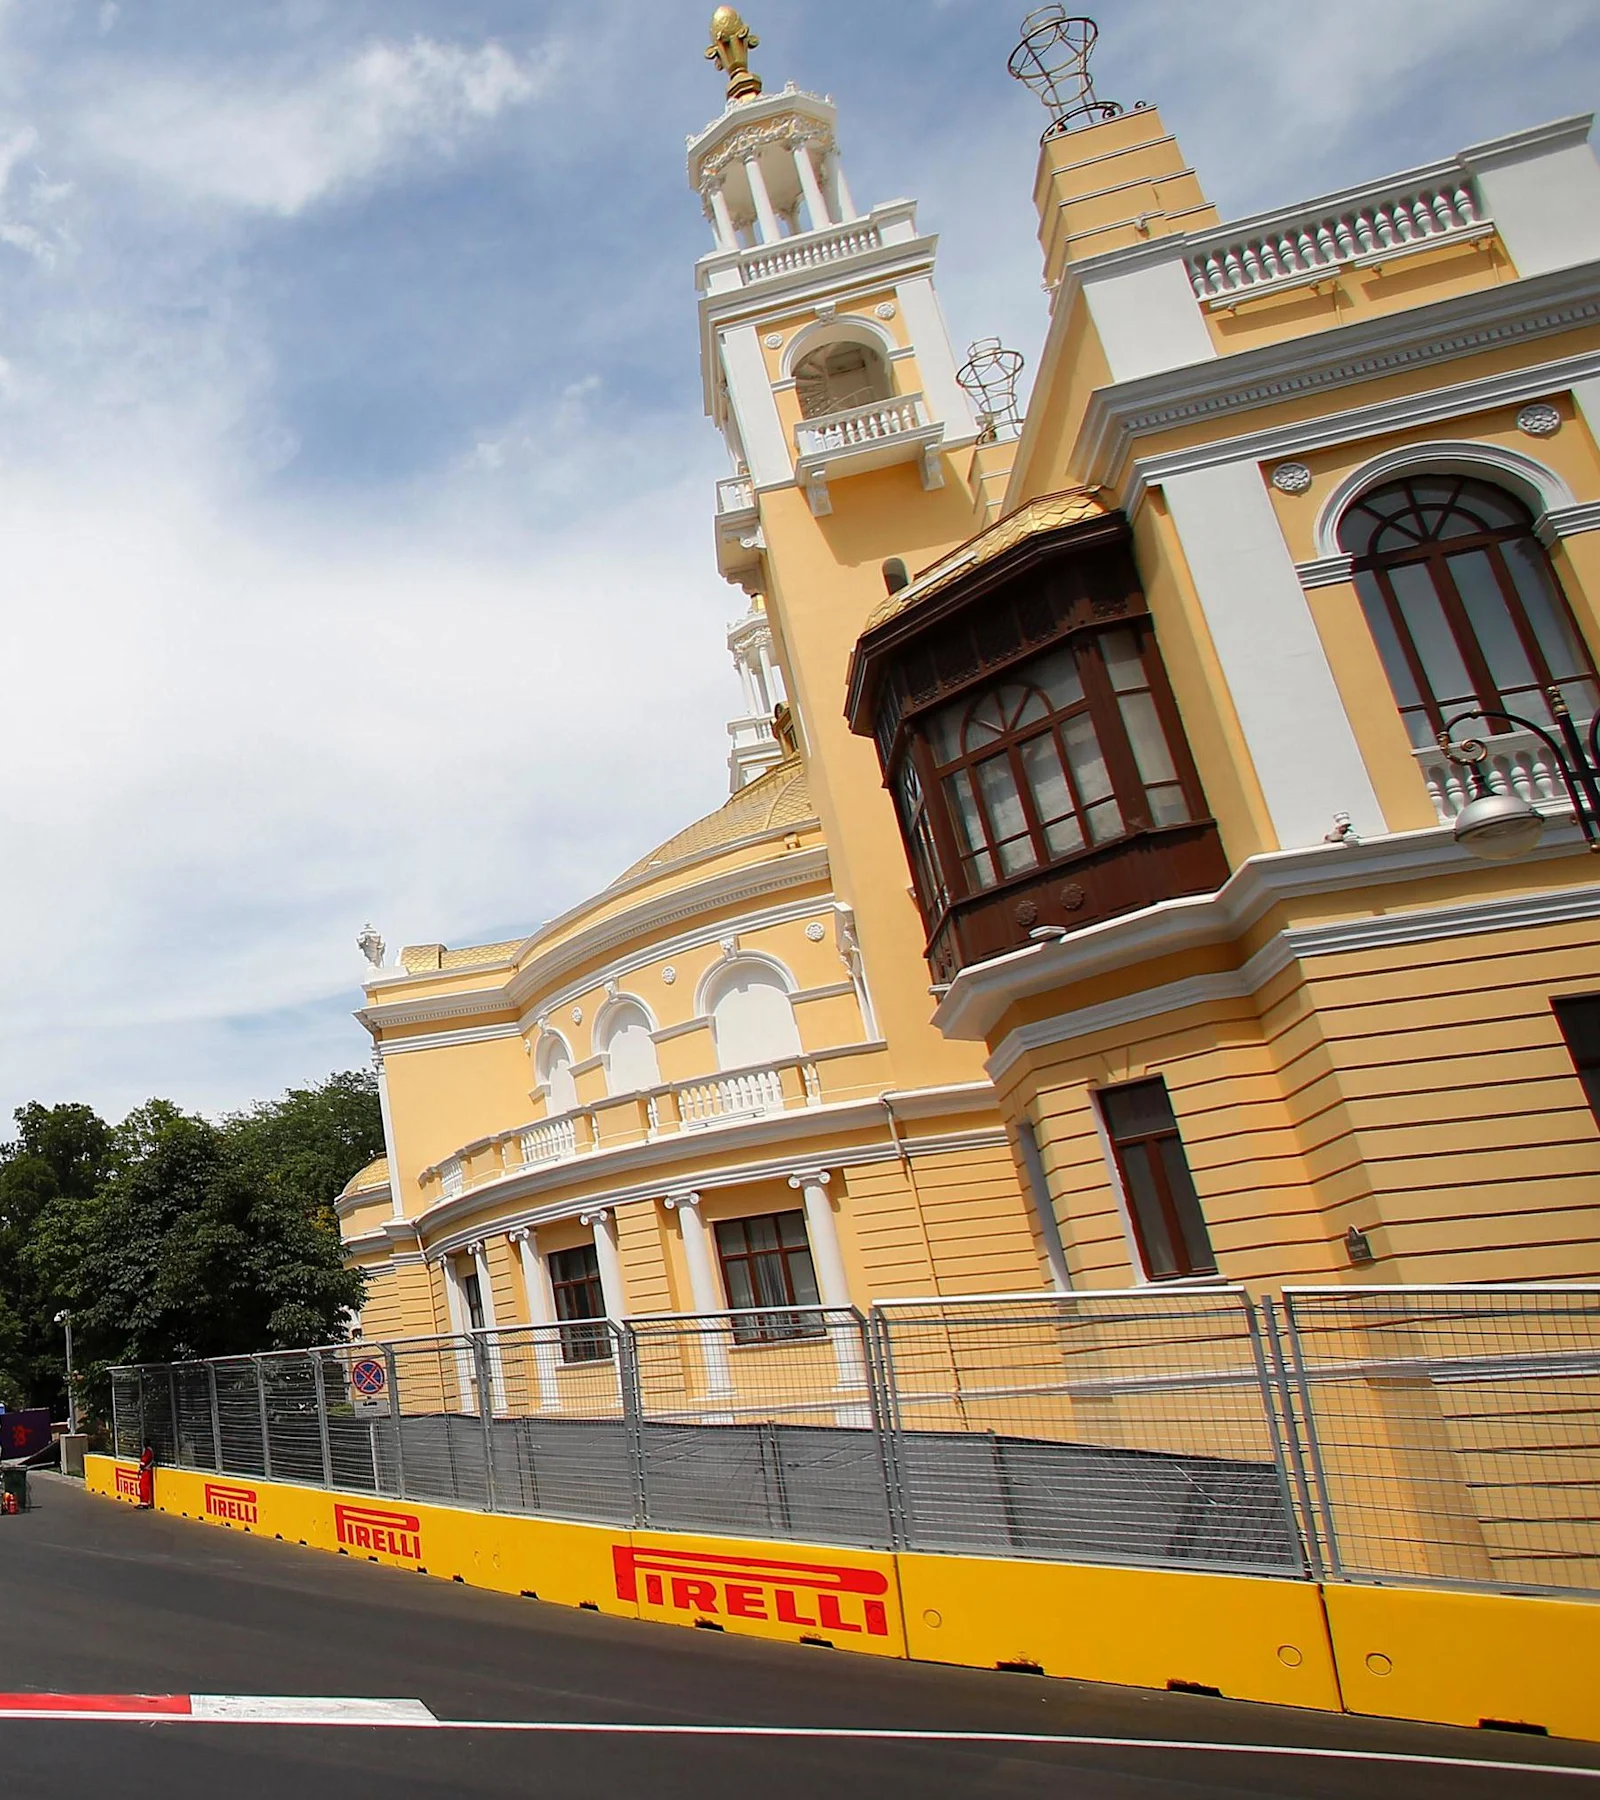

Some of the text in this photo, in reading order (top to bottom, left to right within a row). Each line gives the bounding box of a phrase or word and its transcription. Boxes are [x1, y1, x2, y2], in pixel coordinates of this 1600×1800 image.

[115, 1466, 141, 1497] PIREL
[204, 1483, 258, 1524] PIRELLI
[334, 1503, 421, 1559] PIRELLI
[612, 1545, 889, 1636] PIRELLI
